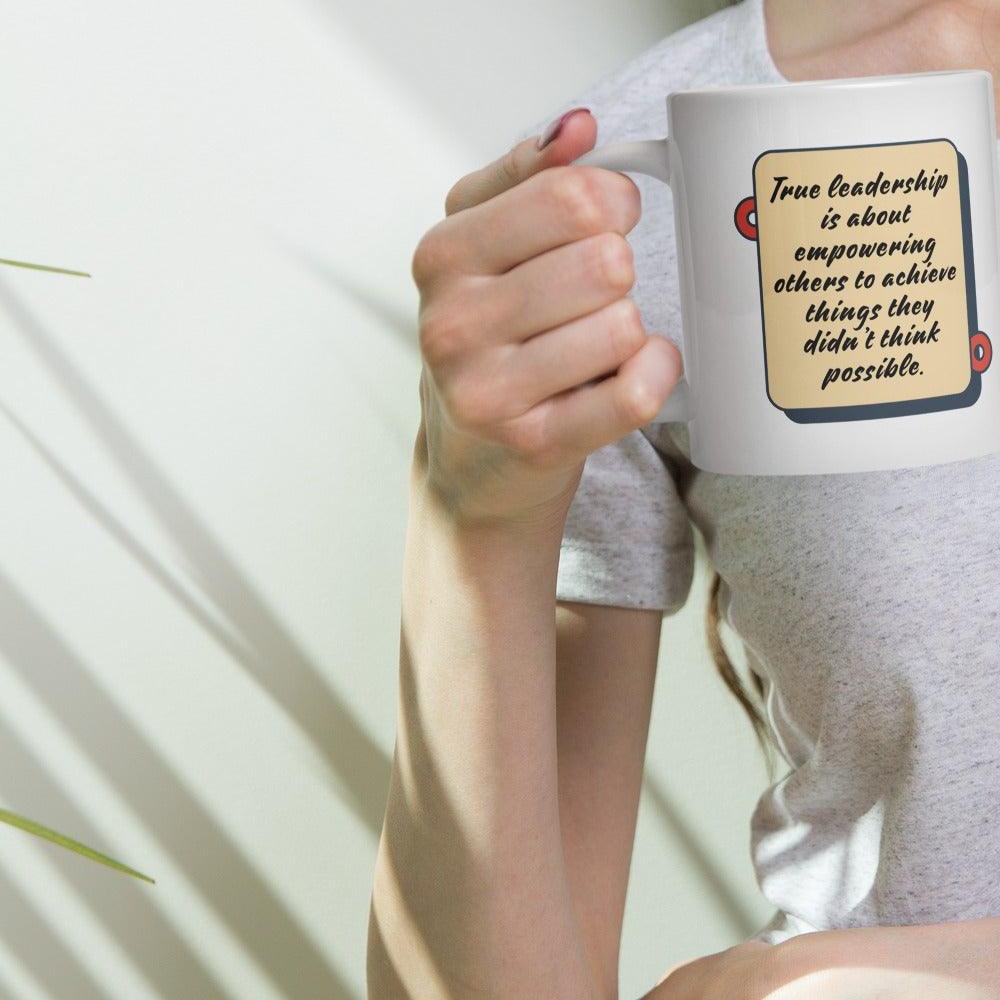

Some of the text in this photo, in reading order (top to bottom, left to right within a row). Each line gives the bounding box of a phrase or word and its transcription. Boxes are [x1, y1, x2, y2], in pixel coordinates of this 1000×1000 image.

[769, 168, 949, 204] True leadership
[820, 204, 912, 231] is about
[794, 232, 937, 268] empowering
[773, 261, 957, 294] others to achieve
[805, 294, 935, 332] things they
[803, 320, 941, 356] didn't think
[820, 352, 924, 391] possible.
